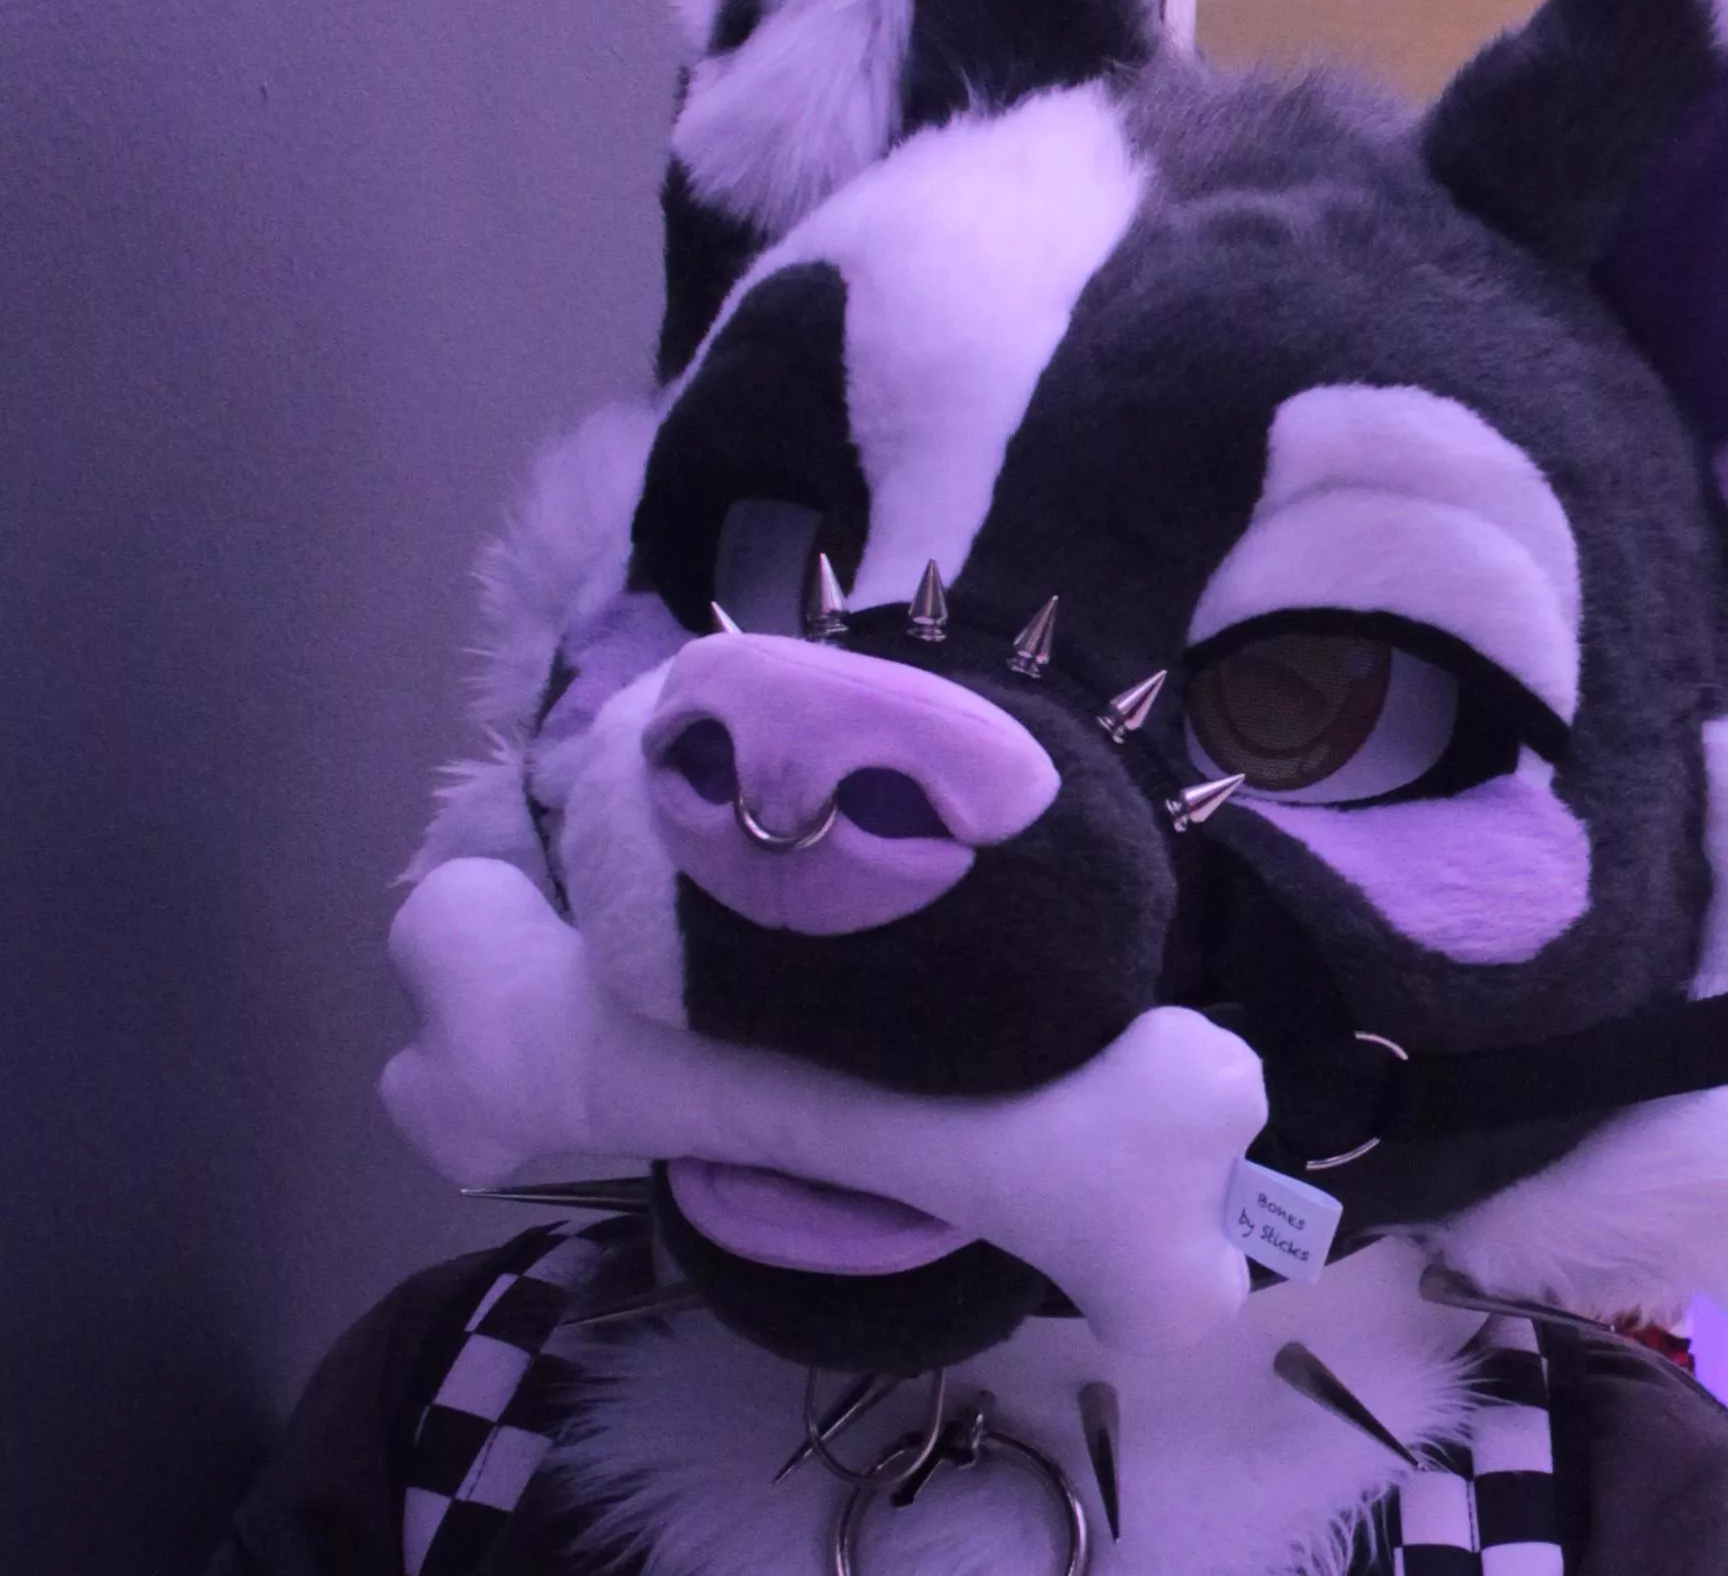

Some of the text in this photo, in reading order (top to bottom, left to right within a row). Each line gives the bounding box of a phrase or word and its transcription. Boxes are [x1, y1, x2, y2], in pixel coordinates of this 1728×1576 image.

[1257, 1193, 1306, 1231] Bones
[1238, 1209, 1309, 1262] by Sticks
